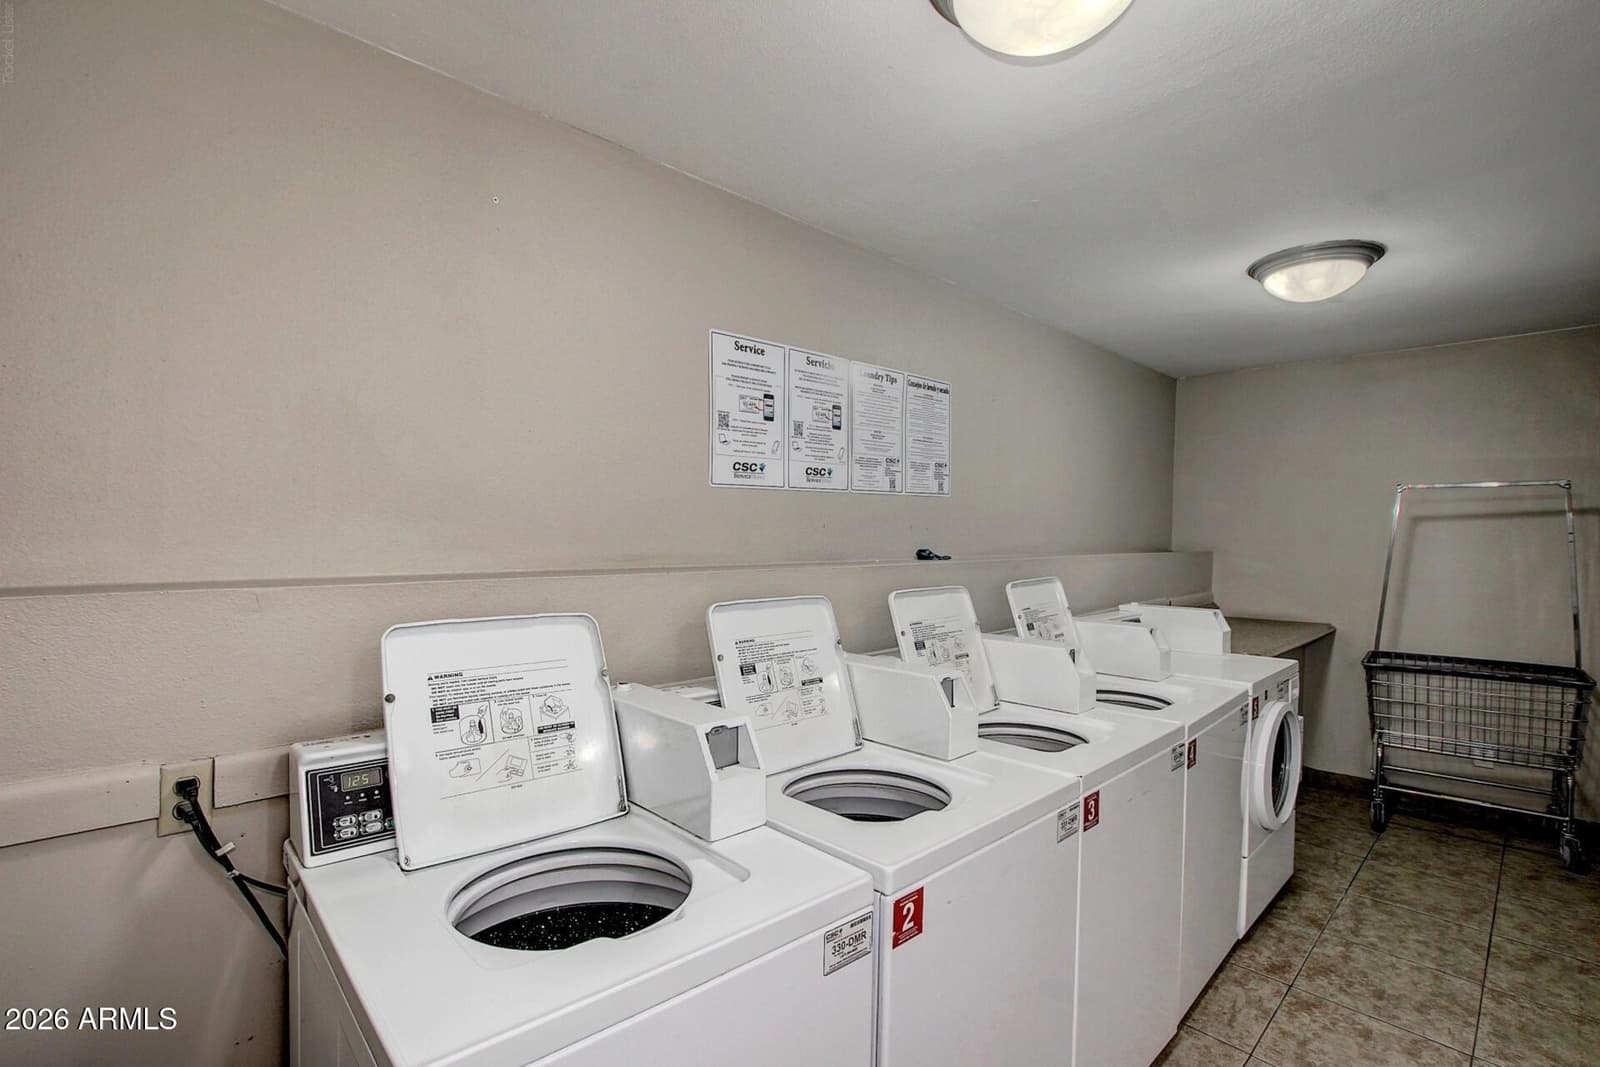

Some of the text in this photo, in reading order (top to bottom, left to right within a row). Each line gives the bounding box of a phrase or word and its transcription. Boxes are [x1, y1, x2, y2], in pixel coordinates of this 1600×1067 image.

[734, 340, 765, 356] Service
[885, 374, 898, 386] Tips
[733, 462, 758, 472] CSC
[805, 467, 826, 477] CSC
[434, 672, 464, 680] WARNING
[347, 773, 369, 787] 125
[1088, 800, 1096, 821] 3
[902, 901, 915, 932] 2
[832, 931, 867, 955] 330-DMR
